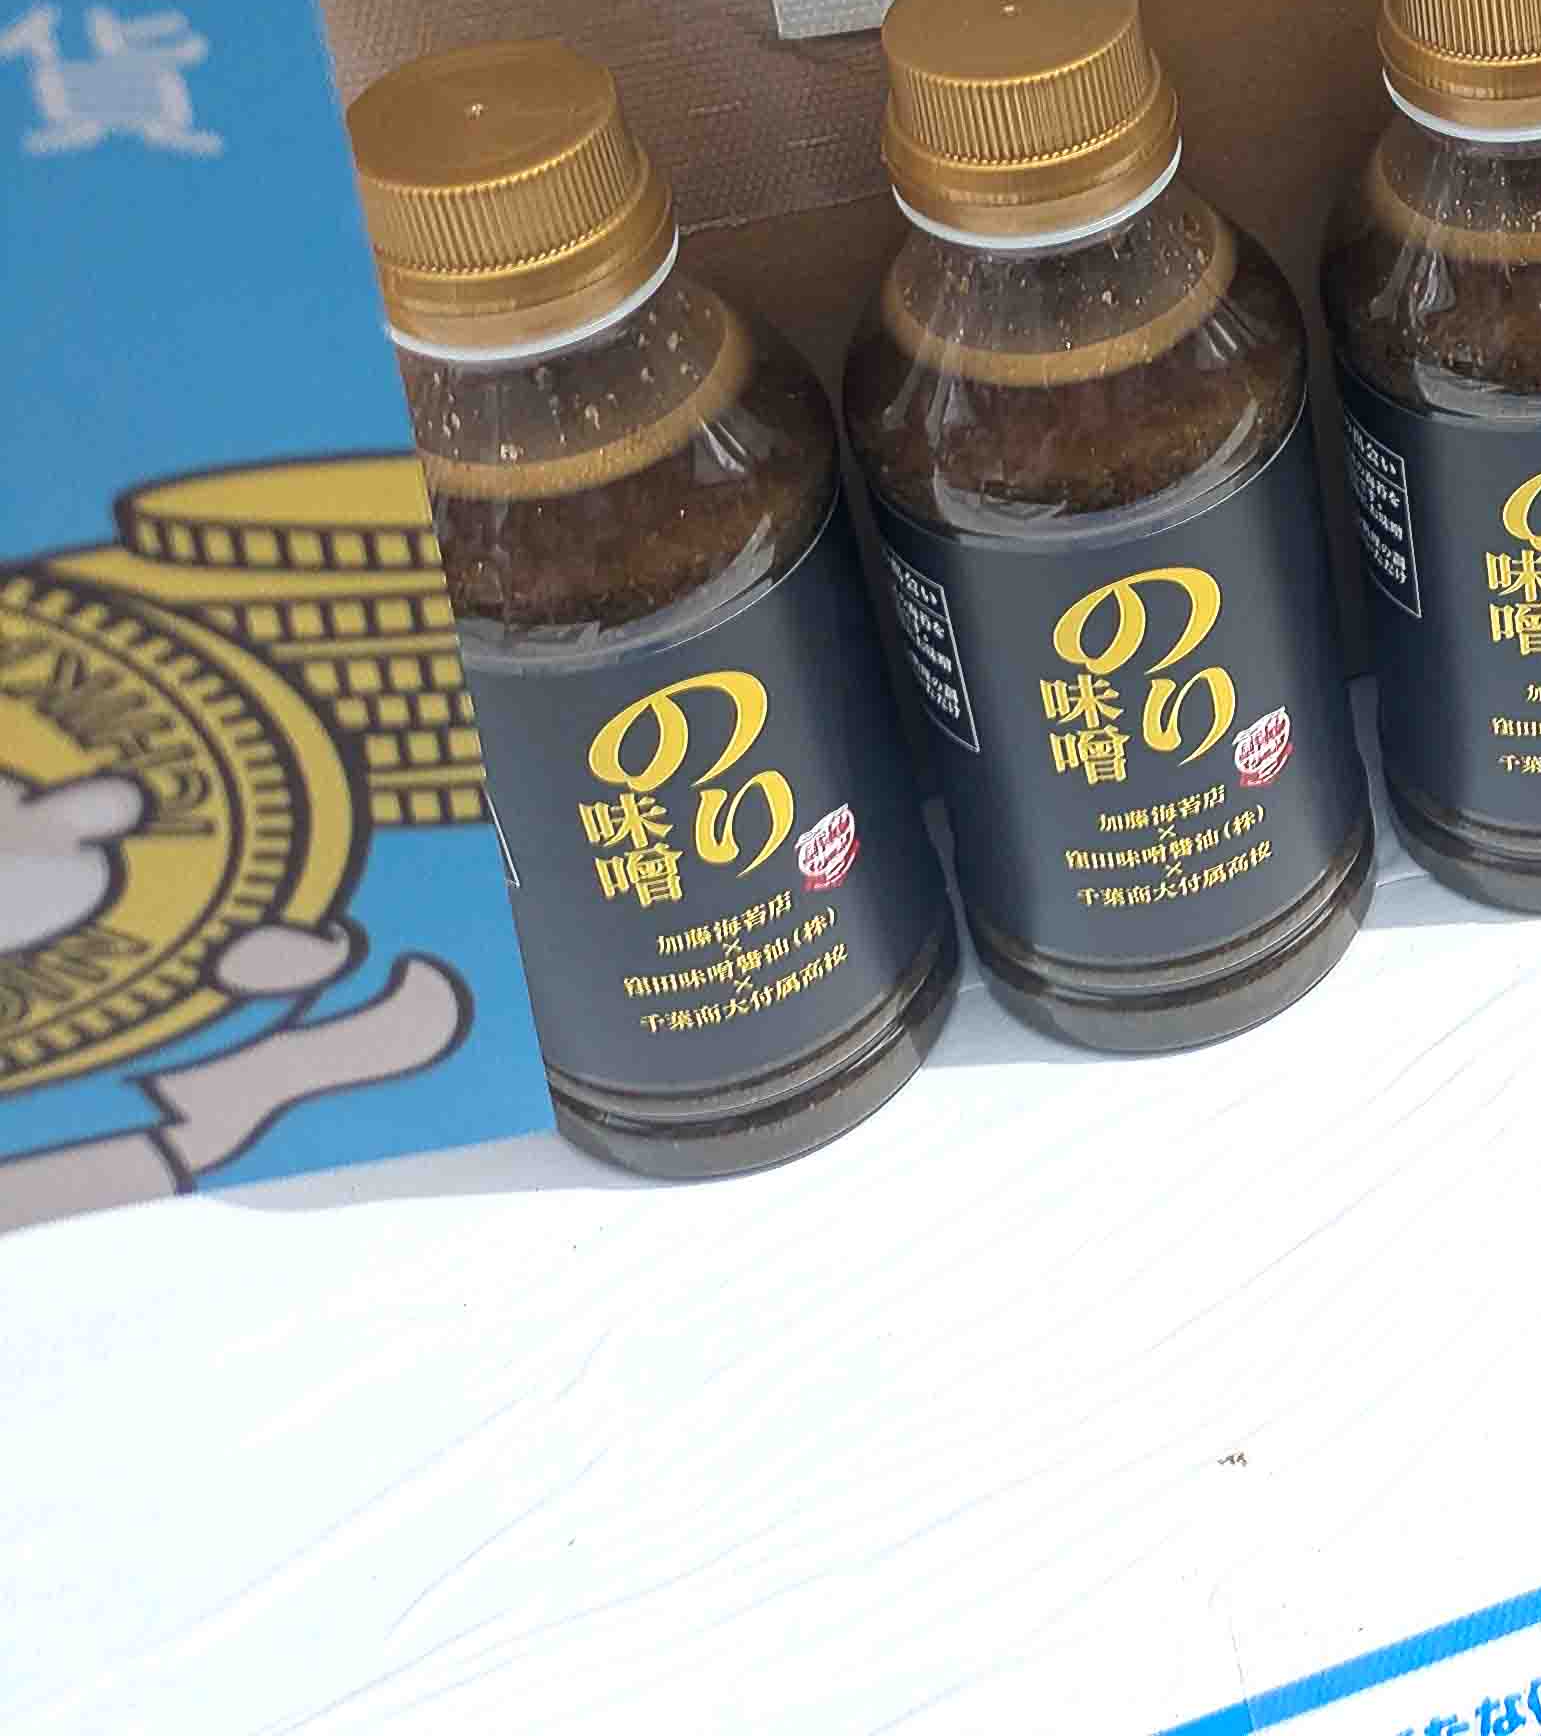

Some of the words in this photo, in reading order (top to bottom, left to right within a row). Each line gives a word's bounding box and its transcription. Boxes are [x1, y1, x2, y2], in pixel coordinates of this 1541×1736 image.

[1053, 567, 1236, 766] のり
[588, 671, 795, 877] のり
[1039, 674, 1132, 785] 味噌
[577, 792, 685, 908] 味噌
[1098, 784, 1226, 832] 加藤海苔店
[656, 890, 792, 957] 加藤海苔店
[1077, 840, 1274, 907] 千葉商大付属高校
[639, 943, 849, 1034] 千葉商大付属高校
